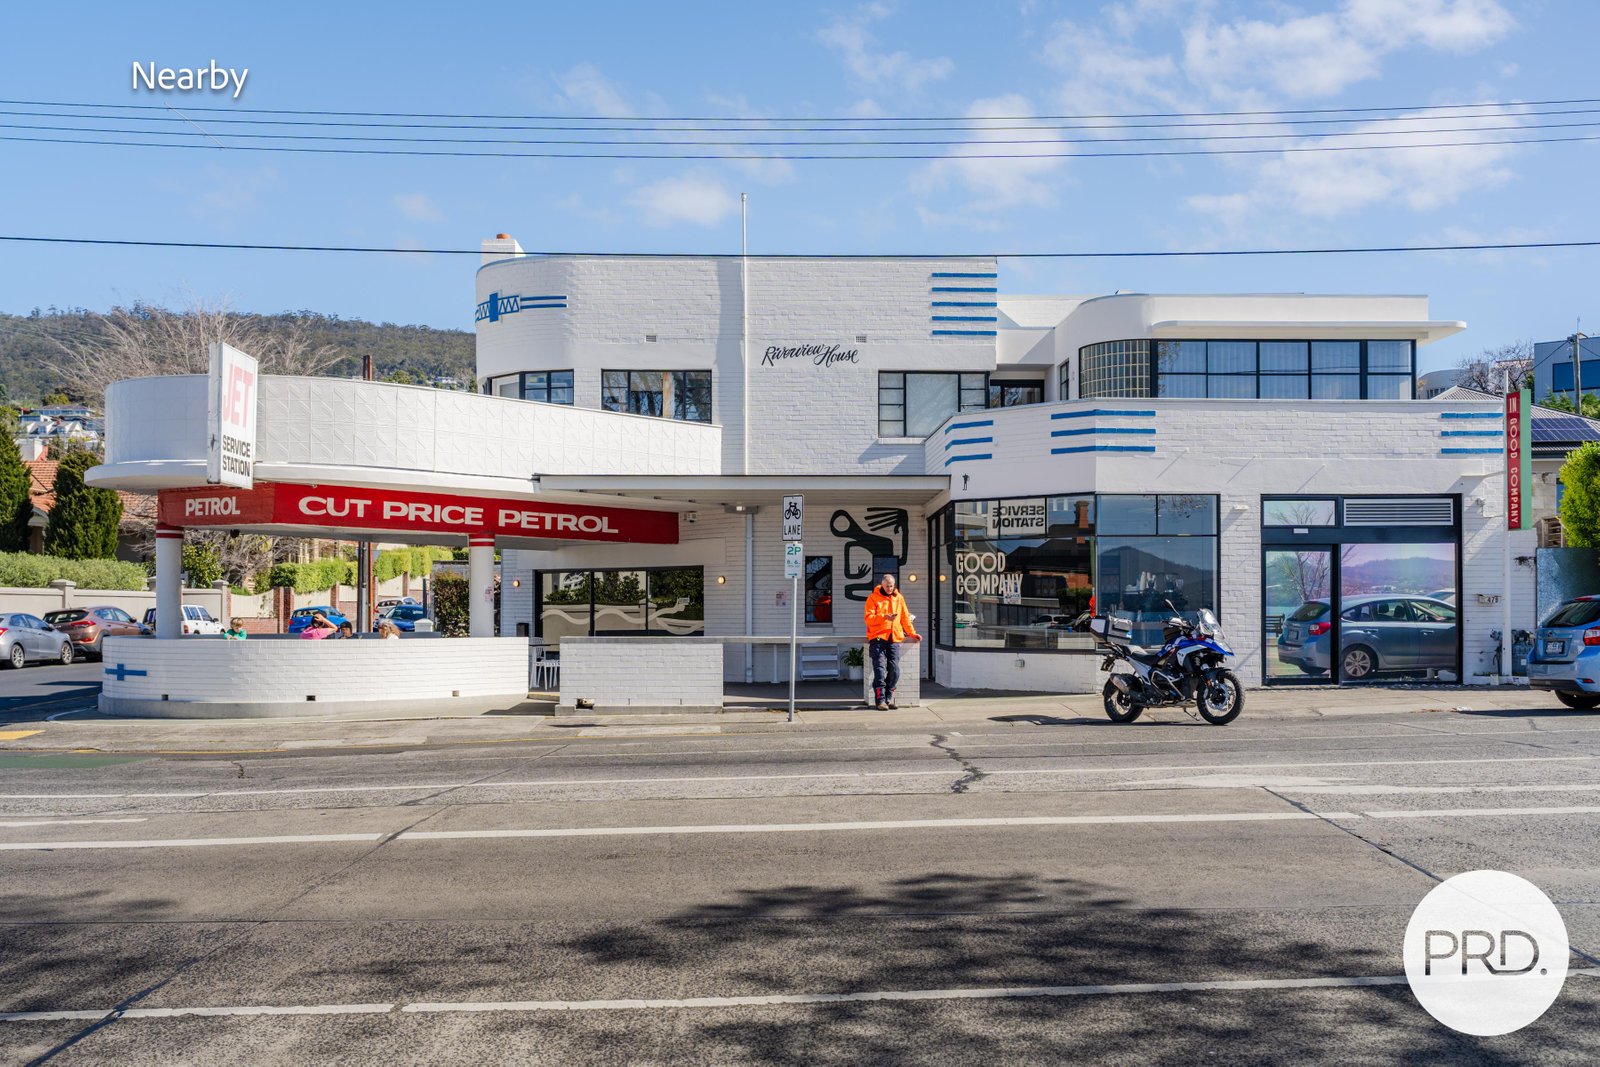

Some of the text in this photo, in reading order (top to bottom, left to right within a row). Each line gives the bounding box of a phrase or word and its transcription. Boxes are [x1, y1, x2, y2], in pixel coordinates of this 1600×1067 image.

[813, 344, 860, 368] House
[222, 363, 254, 429] JET
[222, 434, 251, 458] SERVICE
[222, 455, 251, 477] STATION
[1509, 397, 1519, 524] IN GOOD COMPANY
[185, 496, 241, 517] PETROL
[298, 496, 619, 534] CUT PRICE PETROL
[783, 525, 801, 536] LANE
[786, 546, 802, 555] 2P
[956, 552, 1006, 573] GOOD
[956, 574, 1024, 595] COMPANY
